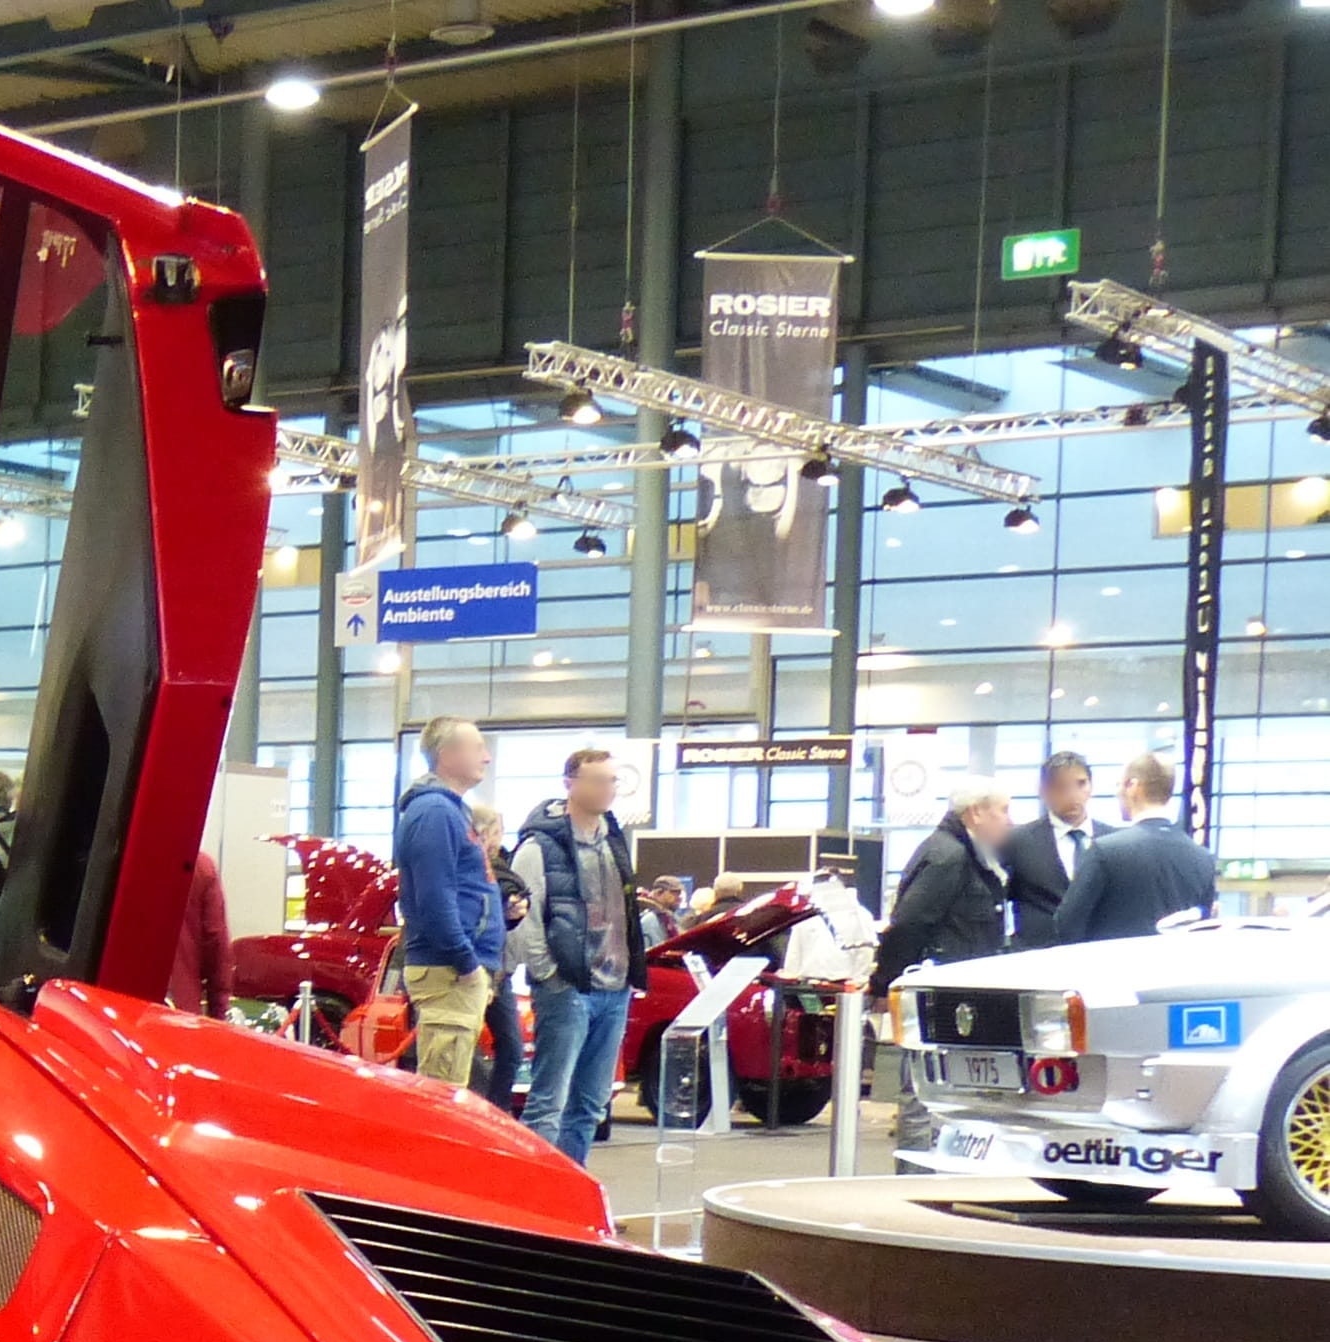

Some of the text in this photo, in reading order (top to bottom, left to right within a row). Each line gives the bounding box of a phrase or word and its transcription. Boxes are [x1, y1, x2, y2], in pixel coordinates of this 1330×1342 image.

[709, 293, 831, 318] ROSIER
[709, 318, 830, 339] Classic Sterne
[383, 580, 532, 603] Ausstellungsbereich
[383, 607, 455, 625] Ambiente
[766, 745, 806, 762] Classic
[964, 1056, 1000, 1085] 1975
[1043, 1138, 1223, 1173] oettinger
